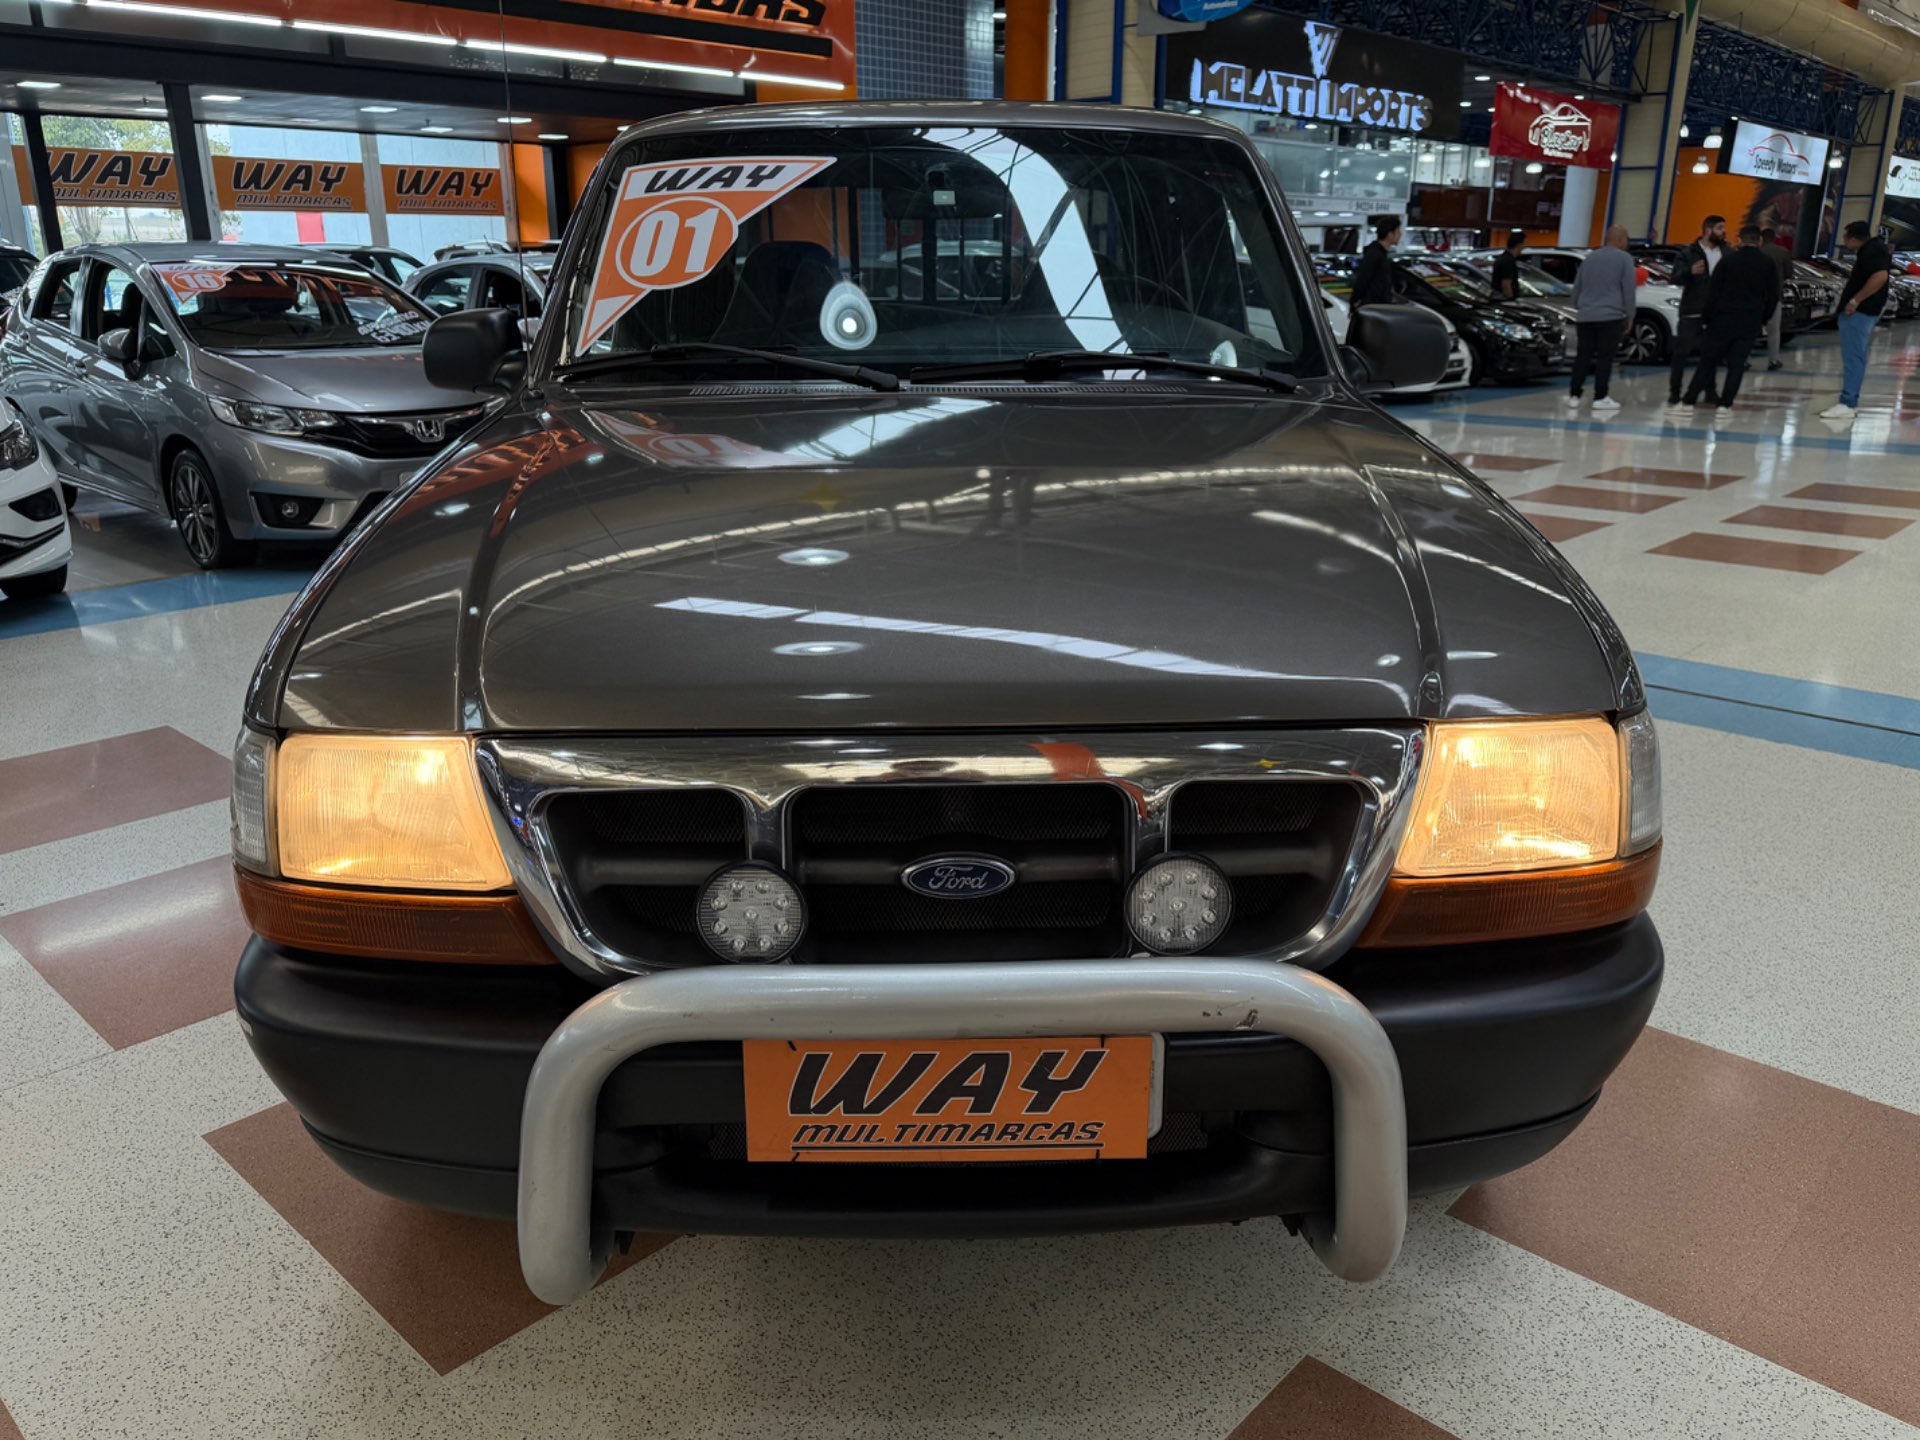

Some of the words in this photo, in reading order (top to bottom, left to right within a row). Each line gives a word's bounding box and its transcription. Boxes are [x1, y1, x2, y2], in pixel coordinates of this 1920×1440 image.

[48, 152, 173, 187] WAY
[232, 161, 347, 193] WAY
[644, 165, 786, 194] WAY
[1754, 154, 1776, 176] Speedy
[1776, 160, 1798, 175] Motors
[395, 167, 494, 198] WAY
[236, 193, 351, 206] MULTIMARCAS
[629, 208, 721, 277] 01
[178, 273, 221, 289] 16
[928, 866, 989, 890] Ford
[787, 1049, 1109, 1116] WAY
[791, 1121, 1105, 1144] MULTIMARCAS
